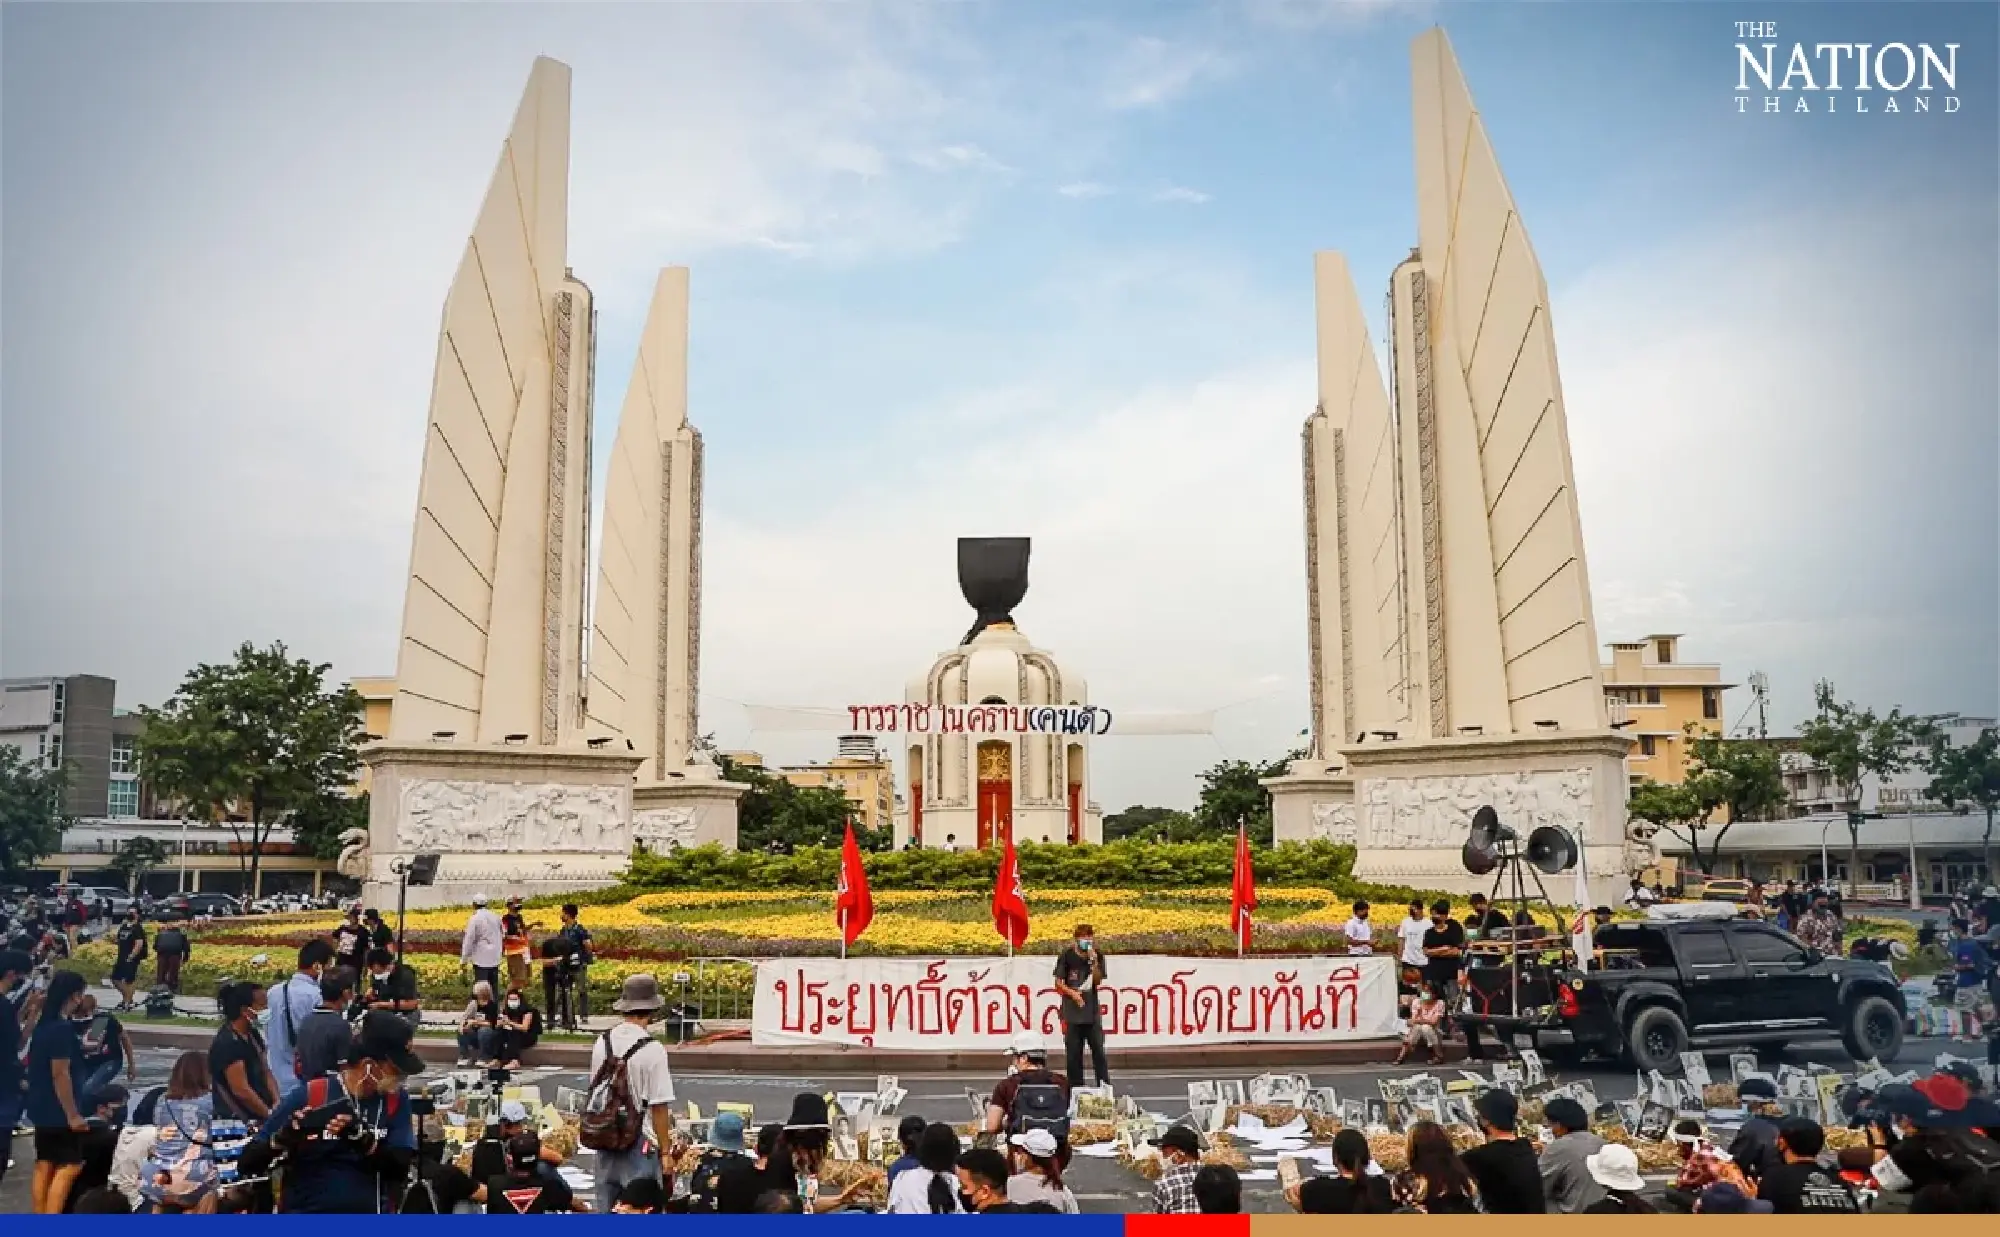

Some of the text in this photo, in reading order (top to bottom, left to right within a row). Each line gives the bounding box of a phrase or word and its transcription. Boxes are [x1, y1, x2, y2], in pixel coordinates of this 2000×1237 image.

[774, 959, 1361, 1047] ประยุทธ์ต้องลออกโดยทันที
